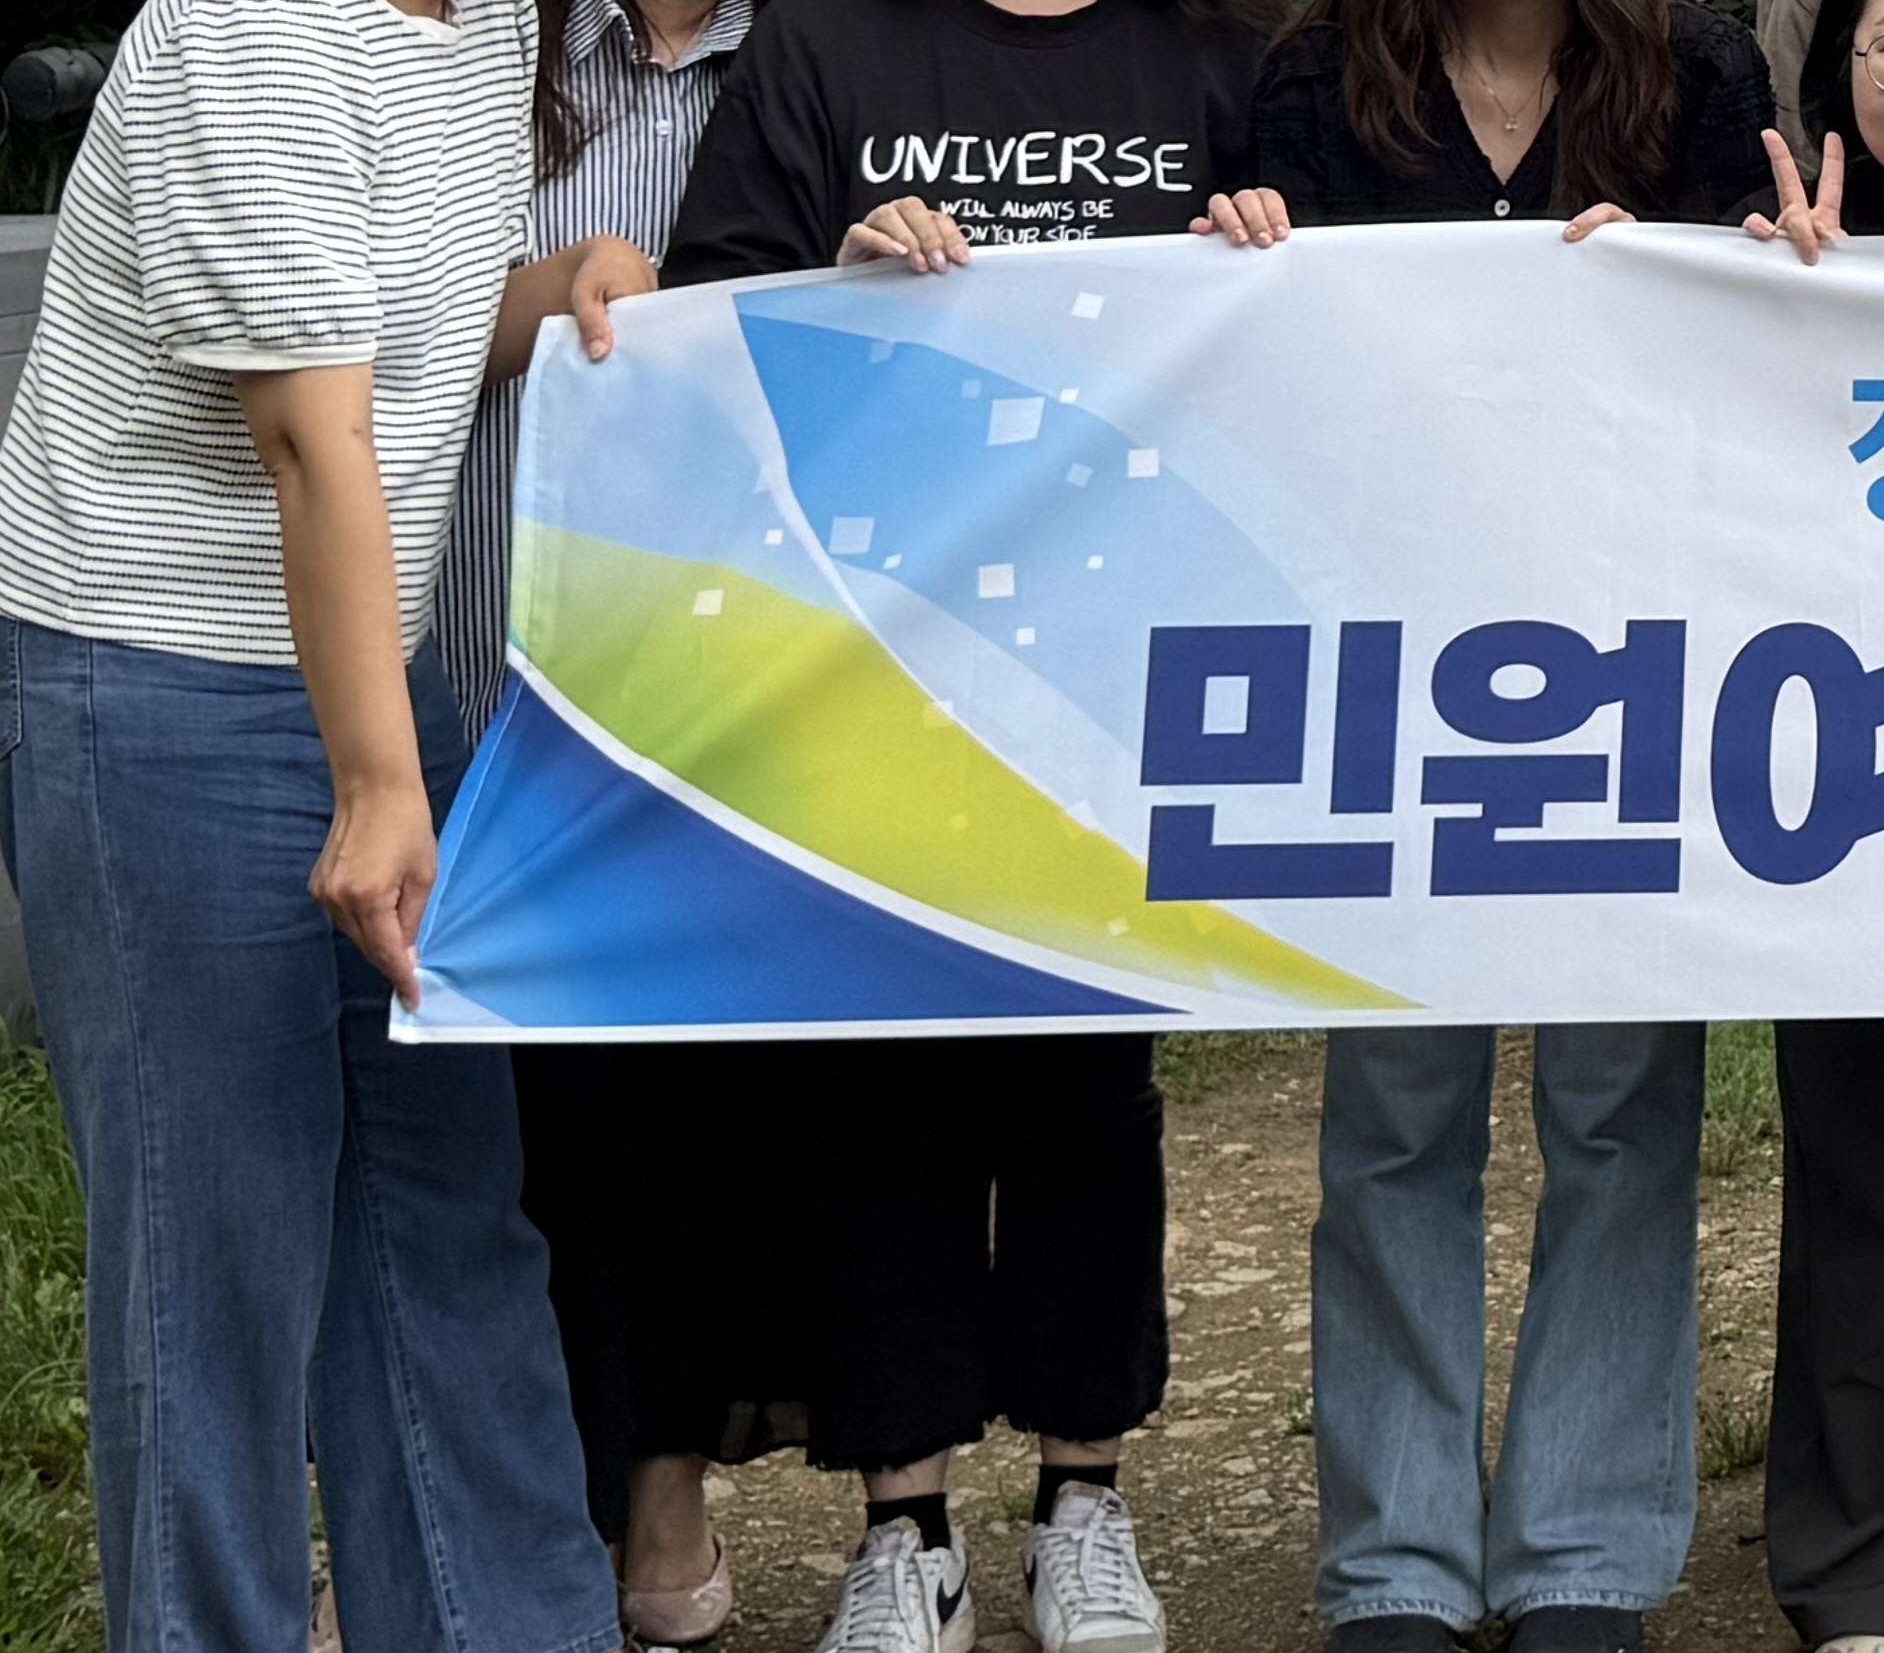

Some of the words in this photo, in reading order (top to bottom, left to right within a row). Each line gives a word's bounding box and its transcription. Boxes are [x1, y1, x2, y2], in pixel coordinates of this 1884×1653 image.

[861, 130, 1193, 192] UNIVERSE
[940, 198, 995, 219] WILL
[1000, 200, 1076, 222] ALWAYS
[1081, 198, 1115, 219] BE
